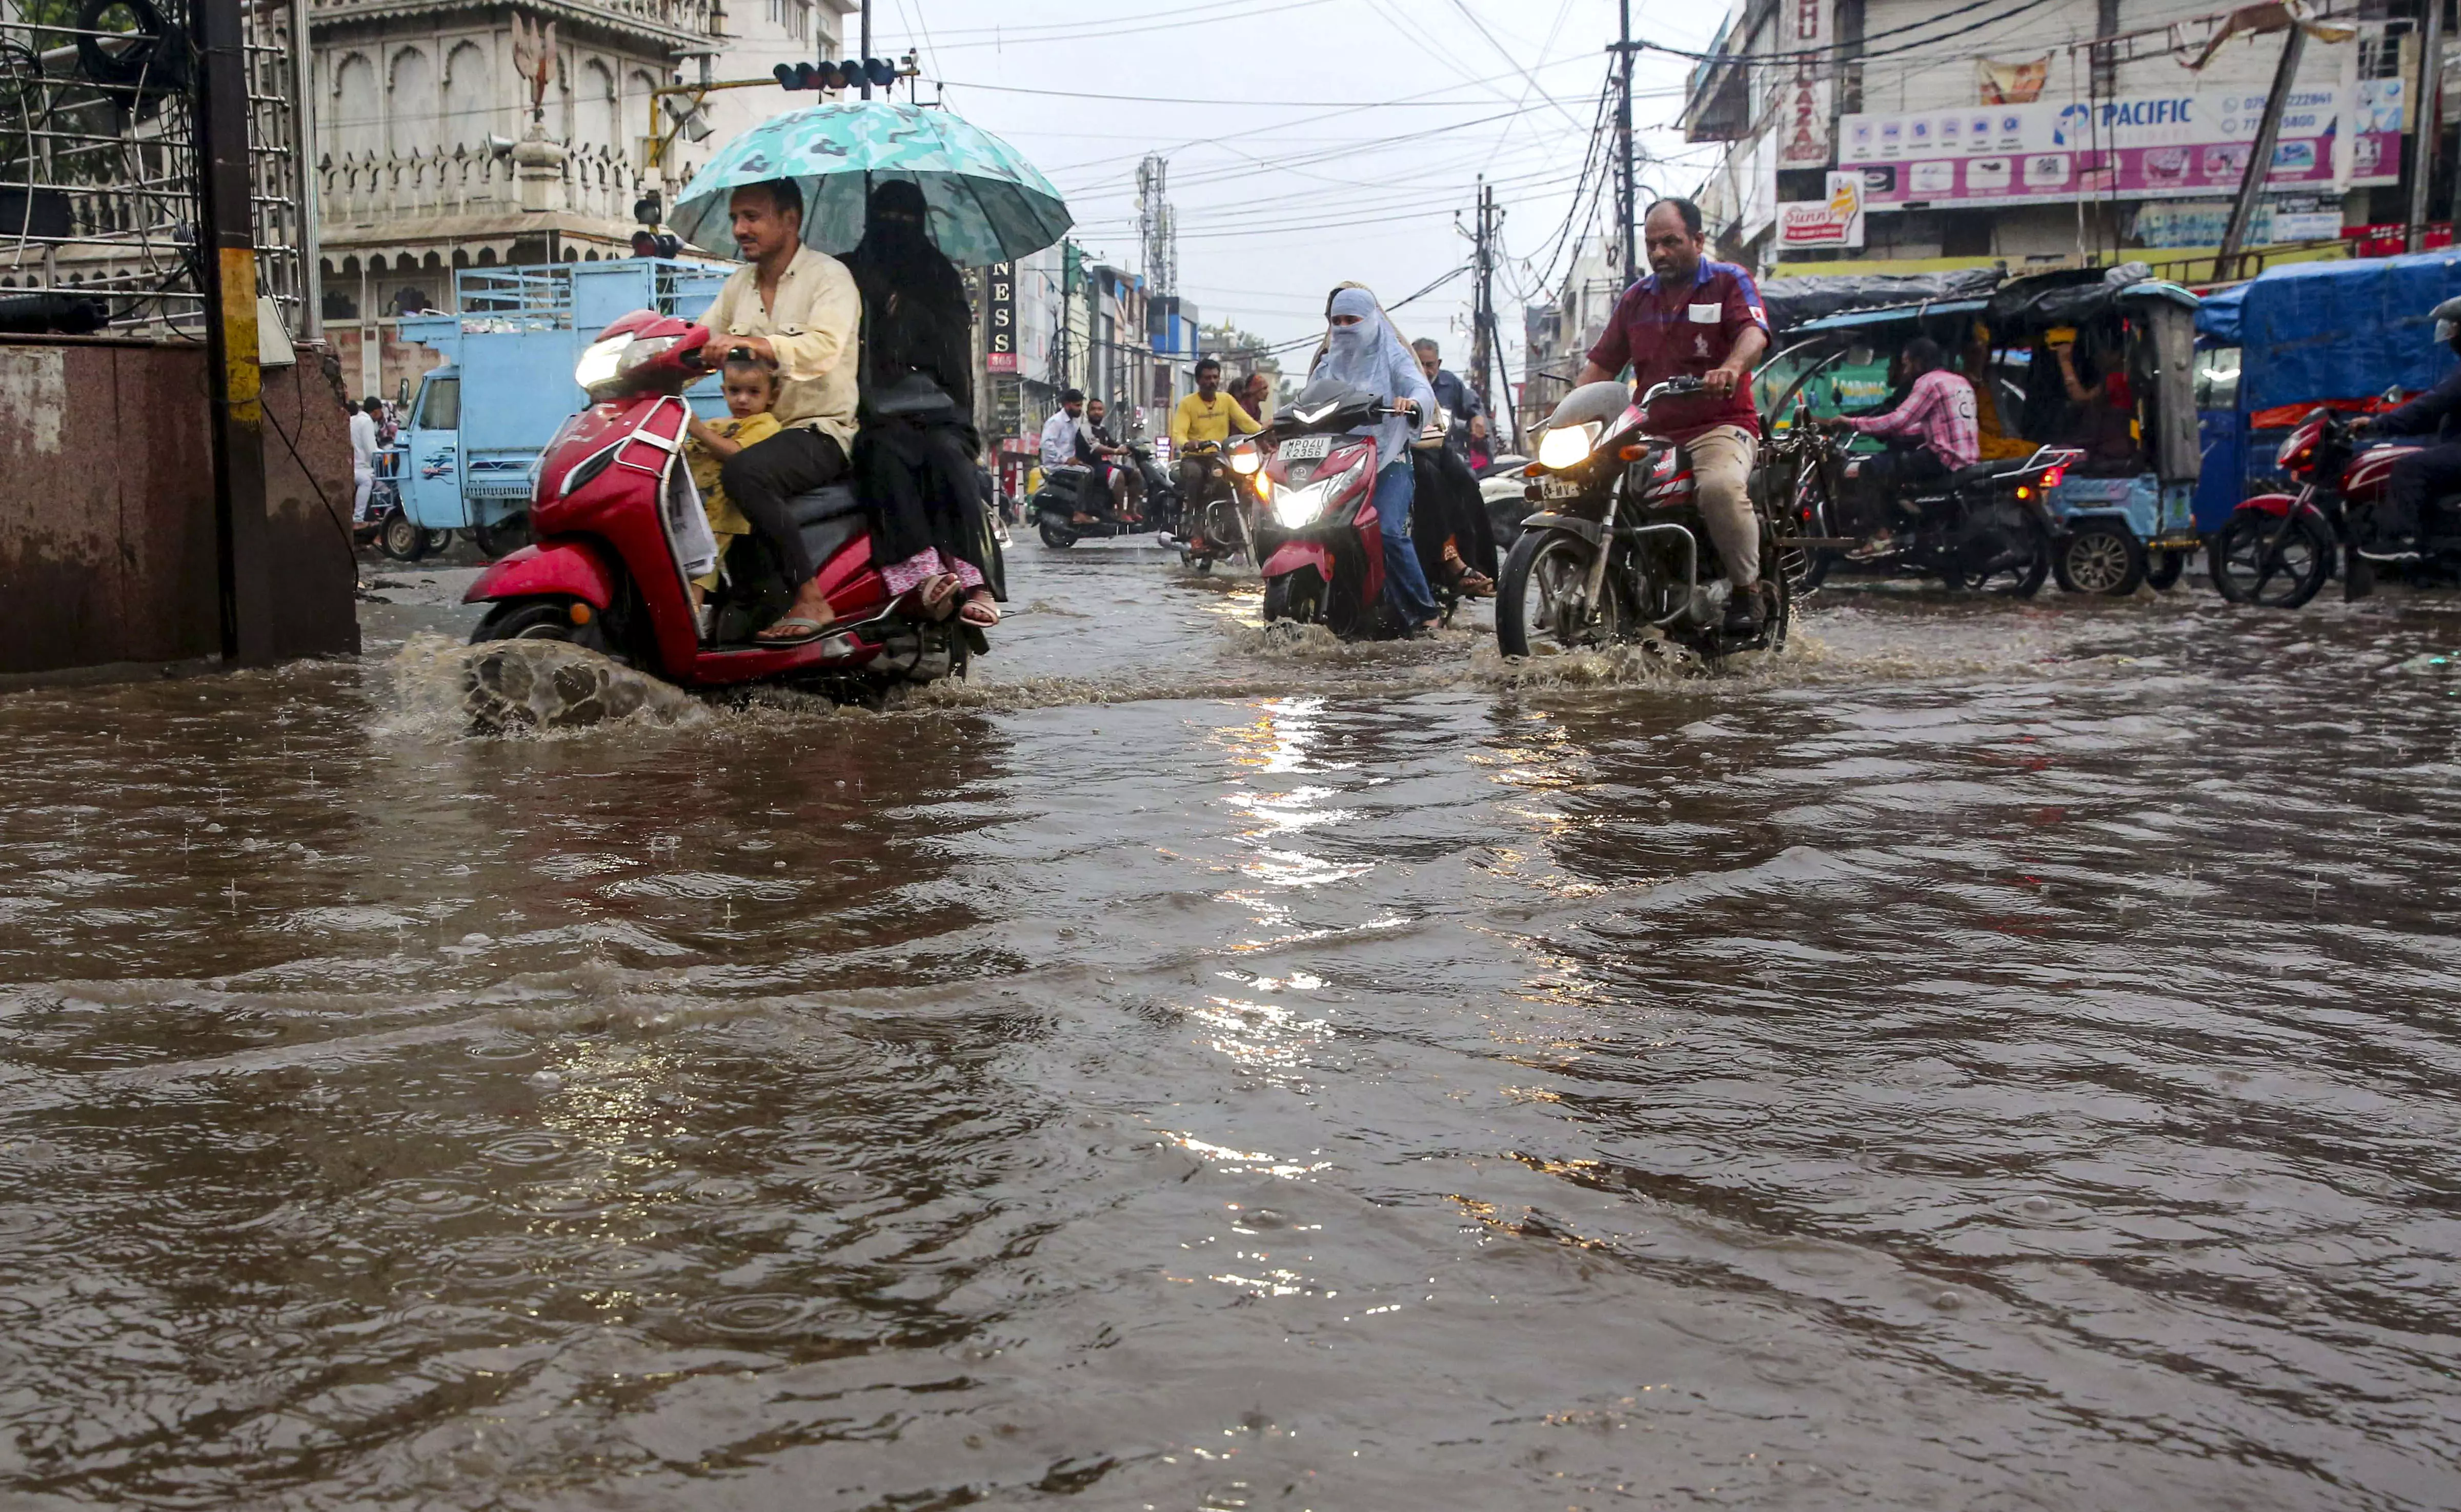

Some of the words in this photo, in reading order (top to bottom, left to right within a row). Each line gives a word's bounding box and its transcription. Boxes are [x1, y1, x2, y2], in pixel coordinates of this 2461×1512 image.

[2102, 98, 2193, 127] PACIFIC
[992, 355, 1012, 366] 365
[1288, 439, 1324, 449] MP04U
[1285, 449, 1321, 458] K2356
